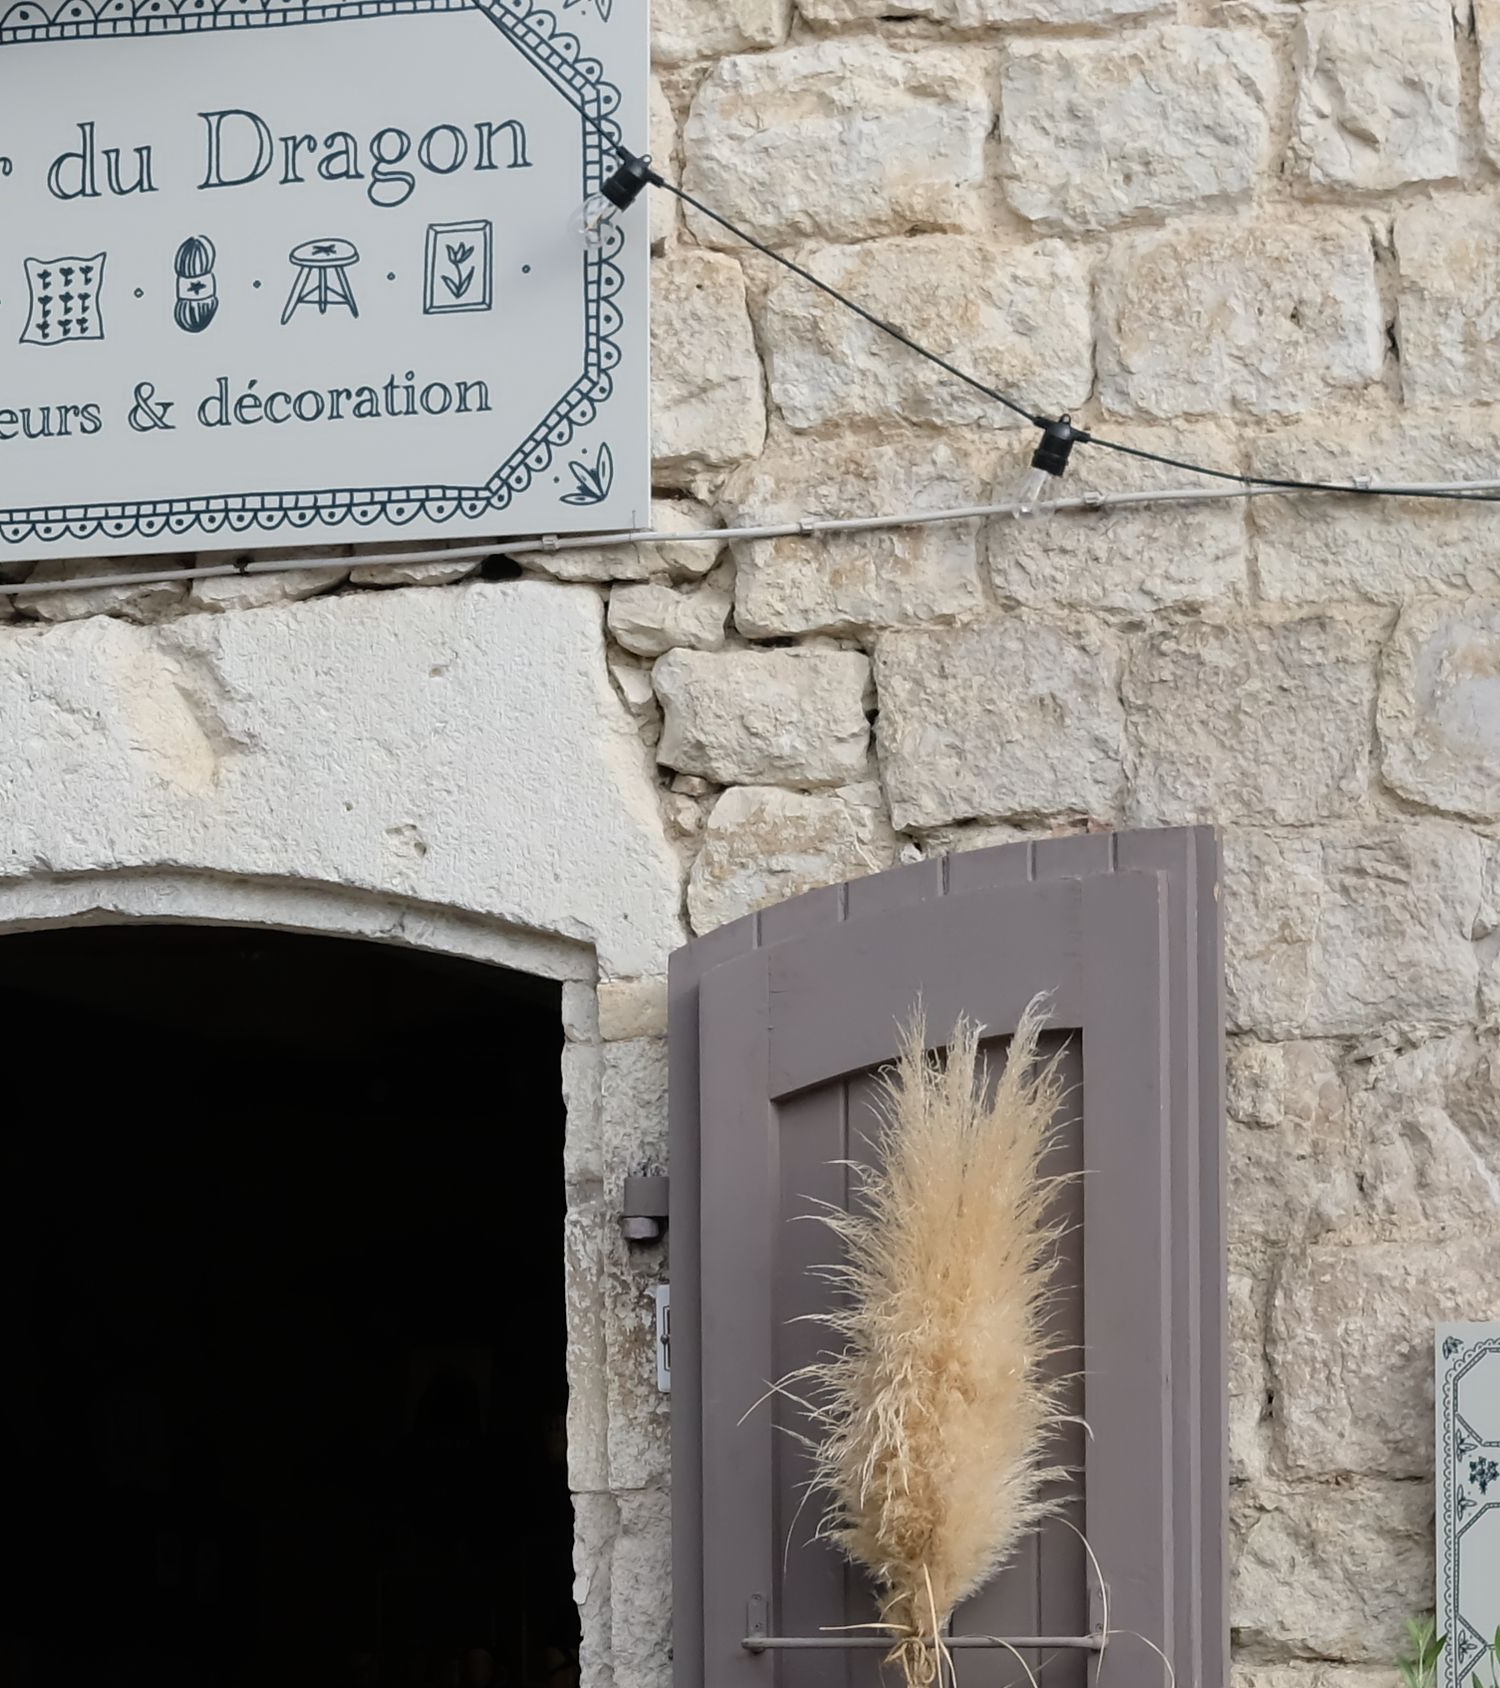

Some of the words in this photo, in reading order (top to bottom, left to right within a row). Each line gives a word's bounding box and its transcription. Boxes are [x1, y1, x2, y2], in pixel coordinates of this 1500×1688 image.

[45, 120, 158, 202] du
[195, 108, 534, 207] Dragon
[128, 379, 177, 433] &
[196, 368, 494, 429] décoration
